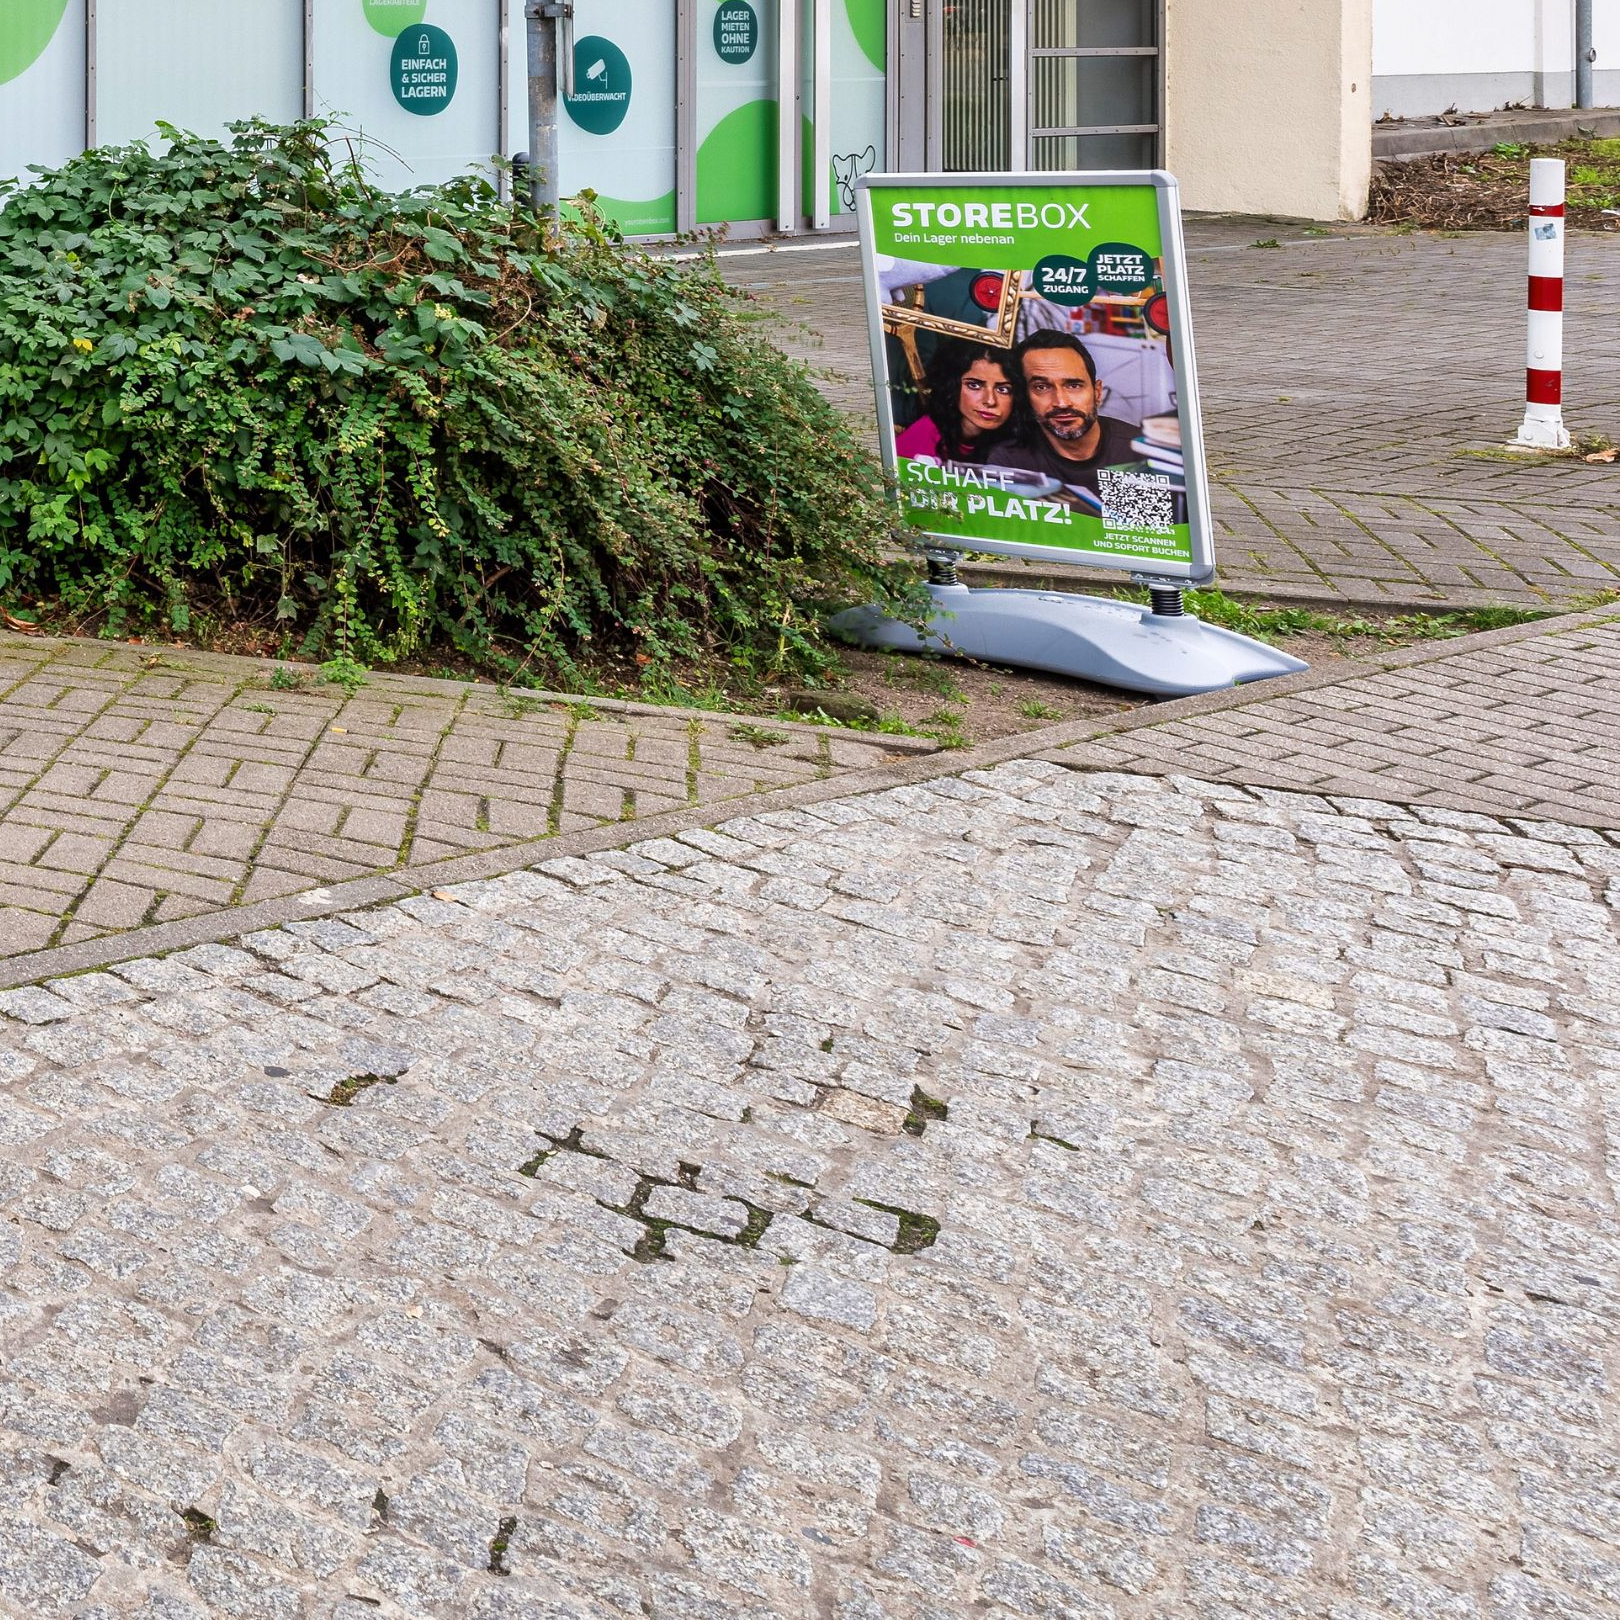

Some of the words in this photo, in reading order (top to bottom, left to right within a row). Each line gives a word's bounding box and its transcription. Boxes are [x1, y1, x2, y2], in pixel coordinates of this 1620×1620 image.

[721, 10, 750, 21] LAGER
[721, 22, 750, 32] MIETEN
[721, 33, 750, 44] OHNE
[721, 45, 750, 54] KAUTION
[401, 58, 447, 70] EINFACH
[401, 72, 410, 83] &
[411, 72, 447, 83] SICHER
[401, 86, 447, 98] LAGERN
[892, 202, 1091, 229] STOREBOX
[894, 232, 921, 243] Dein
[924, 232, 957, 246] Lager
[960, 233, 1015, 245] nebenan
[1096, 253, 1143, 265] JETZT
[1041, 266, 1087, 284] 24/7
[1097, 264, 1145, 275] PLATZ
[1097, 274, 1146, 282] SCHAFFEN
[1043, 285, 1089, 294] ZUGANG
[906, 462, 1014, 492] SCHAFF
[967, 491, 1073, 526] PLATZ!
[1104, 532, 1130, 542] JETZT
[1132, 534, 1176, 547] SCANNEN
[1093, 539, 1113, 549] UND
[1114, 542, 1150, 553] SOFORT
[1151, 546, 1191, 559] BUCHEN
